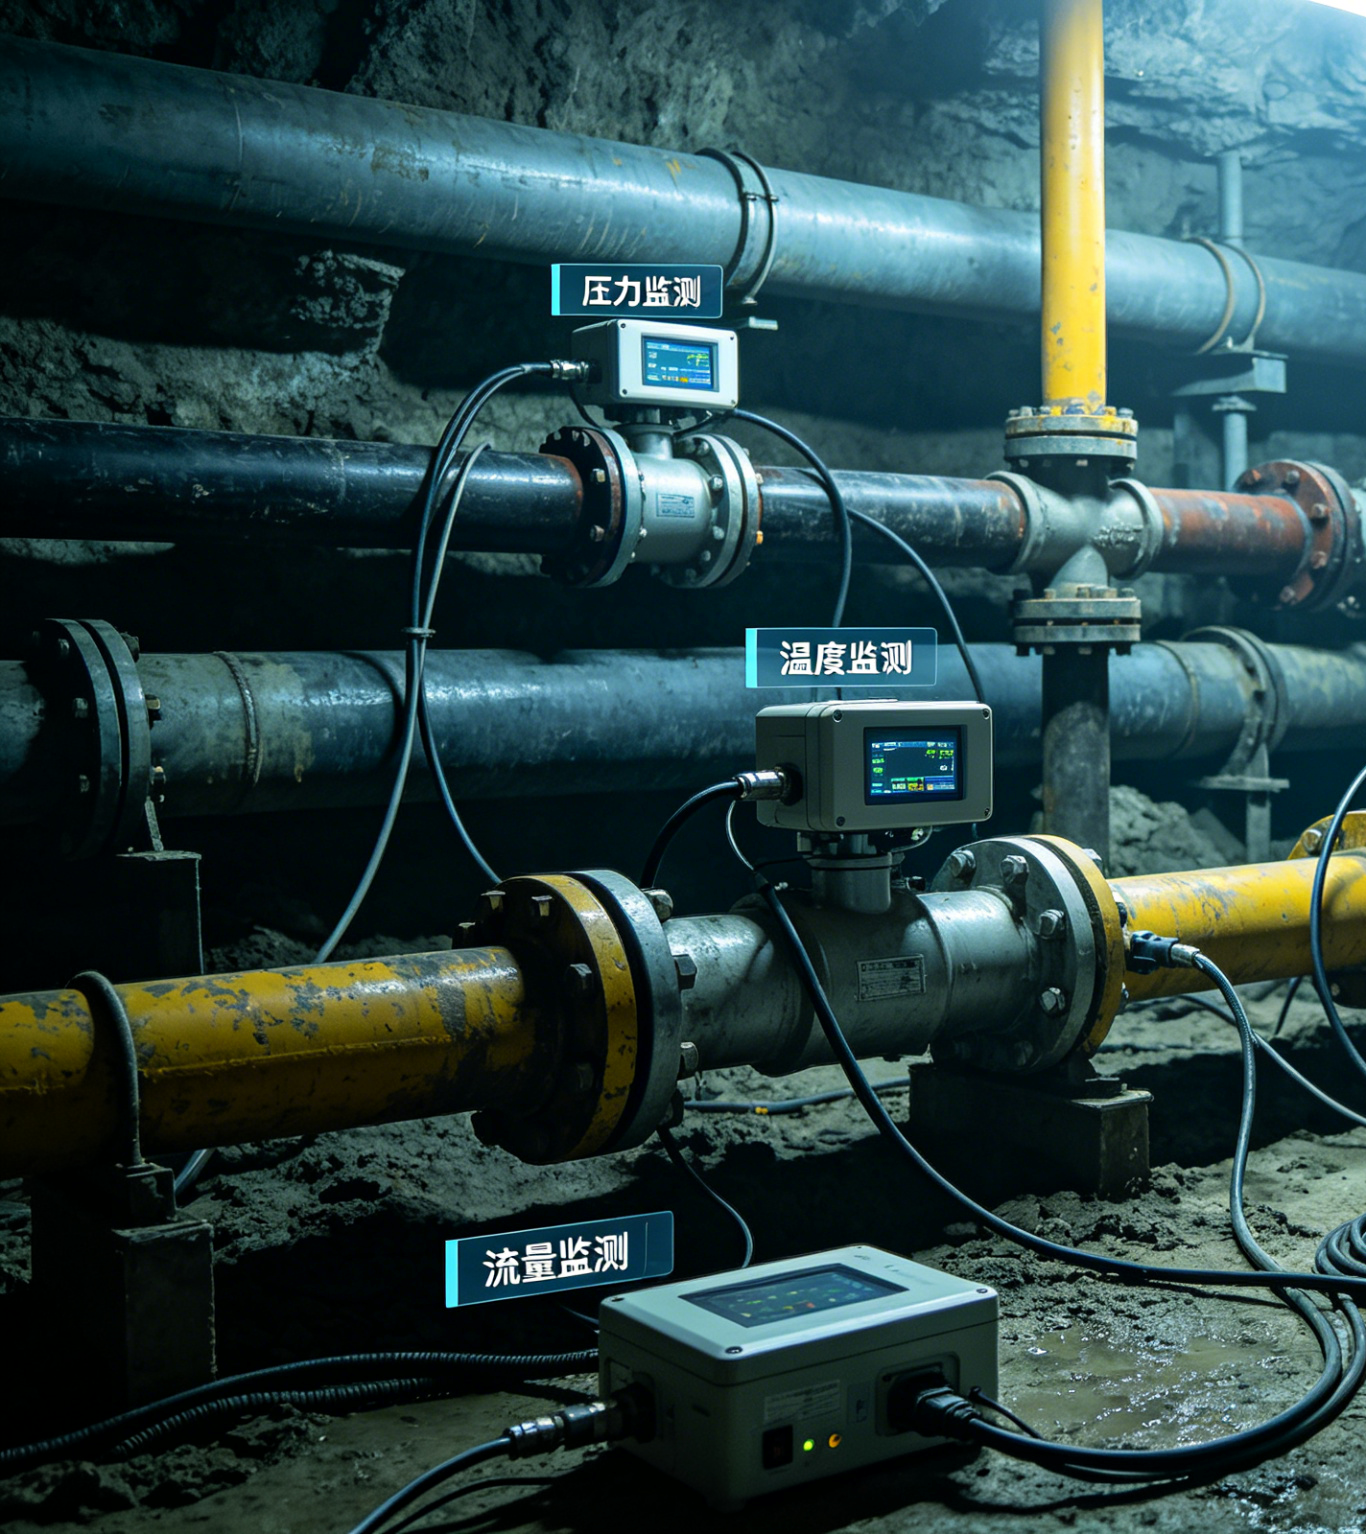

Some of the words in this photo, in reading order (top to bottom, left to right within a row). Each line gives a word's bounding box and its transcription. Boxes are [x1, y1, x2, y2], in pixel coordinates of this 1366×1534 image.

[779, 640, 912, 676] 温度监测
[483, 1231, 628, 1288] 流量监测
